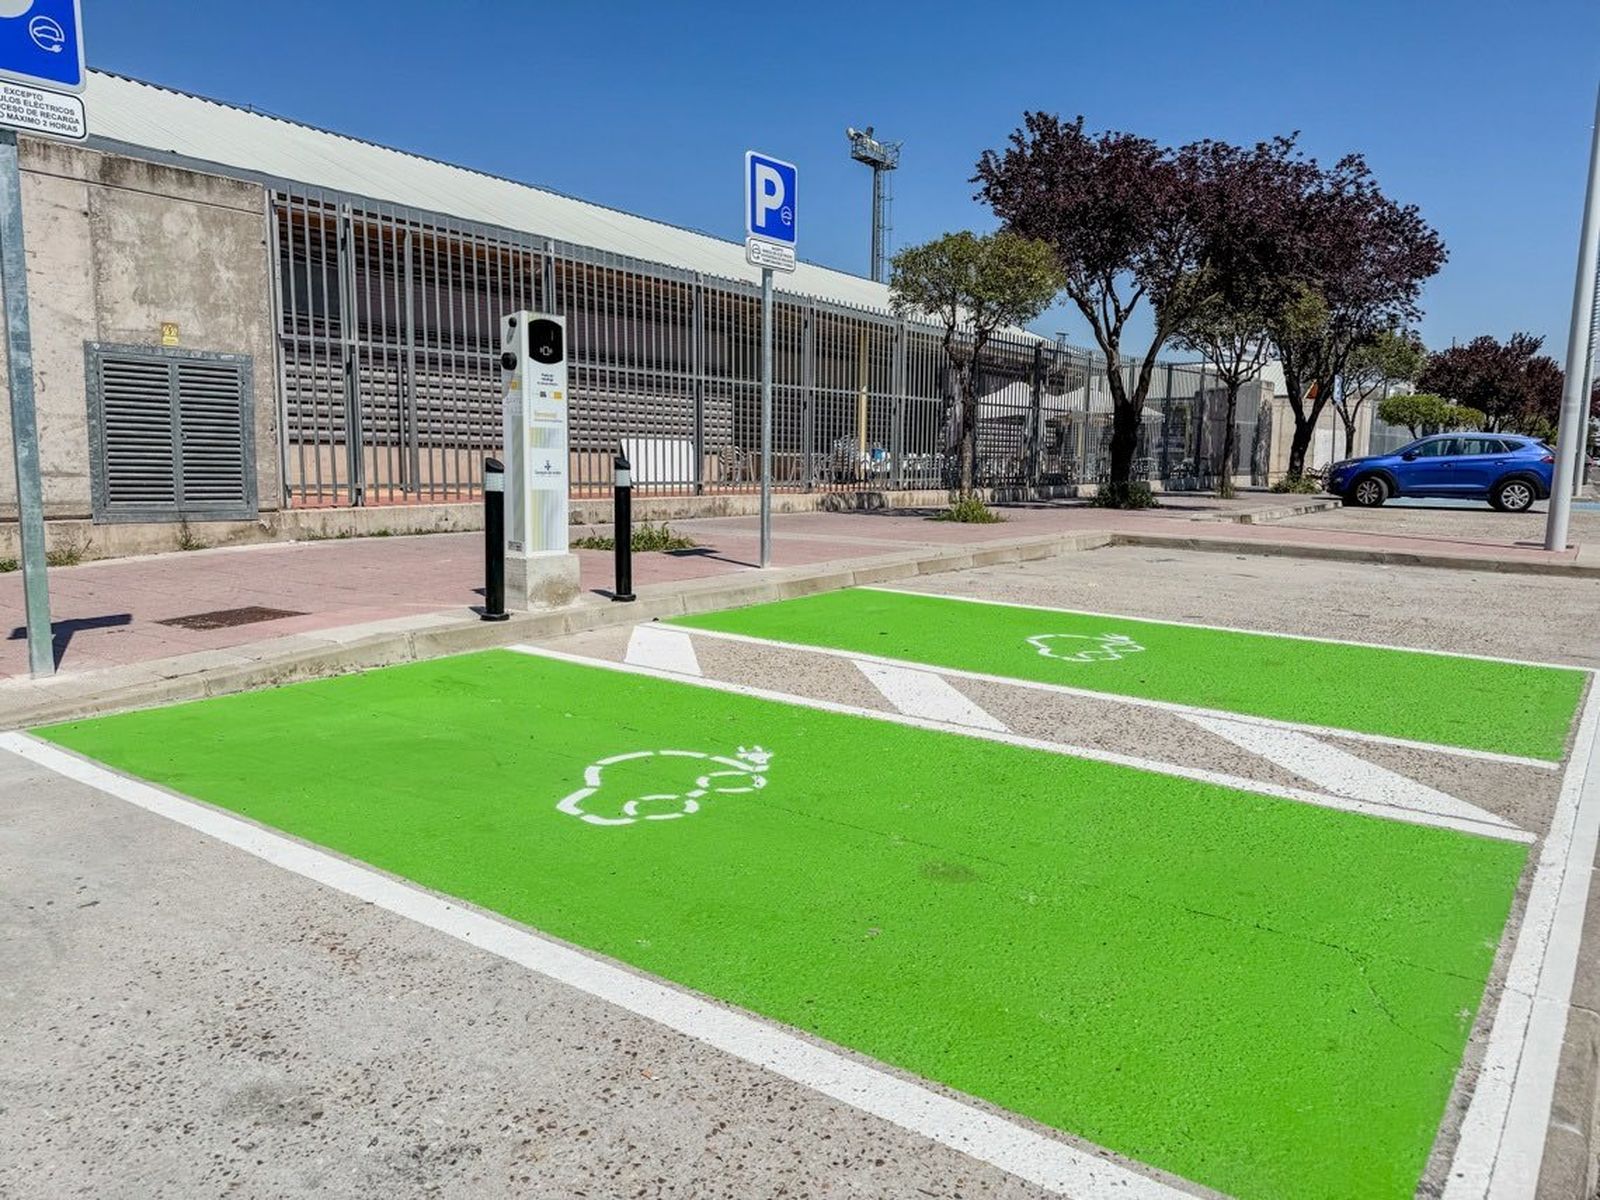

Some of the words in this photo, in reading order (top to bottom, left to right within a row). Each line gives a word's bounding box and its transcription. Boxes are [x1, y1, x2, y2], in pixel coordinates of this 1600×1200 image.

[3, 87, 43, 101] EXCEPTO
[0, 103, 24, 114] CESO
[26, 108, 38, 117] DE
[40, 111, 80, 125] RECARGA
[49, 121, 78, 132] HORAS
[755, 162, 785, 228] P
